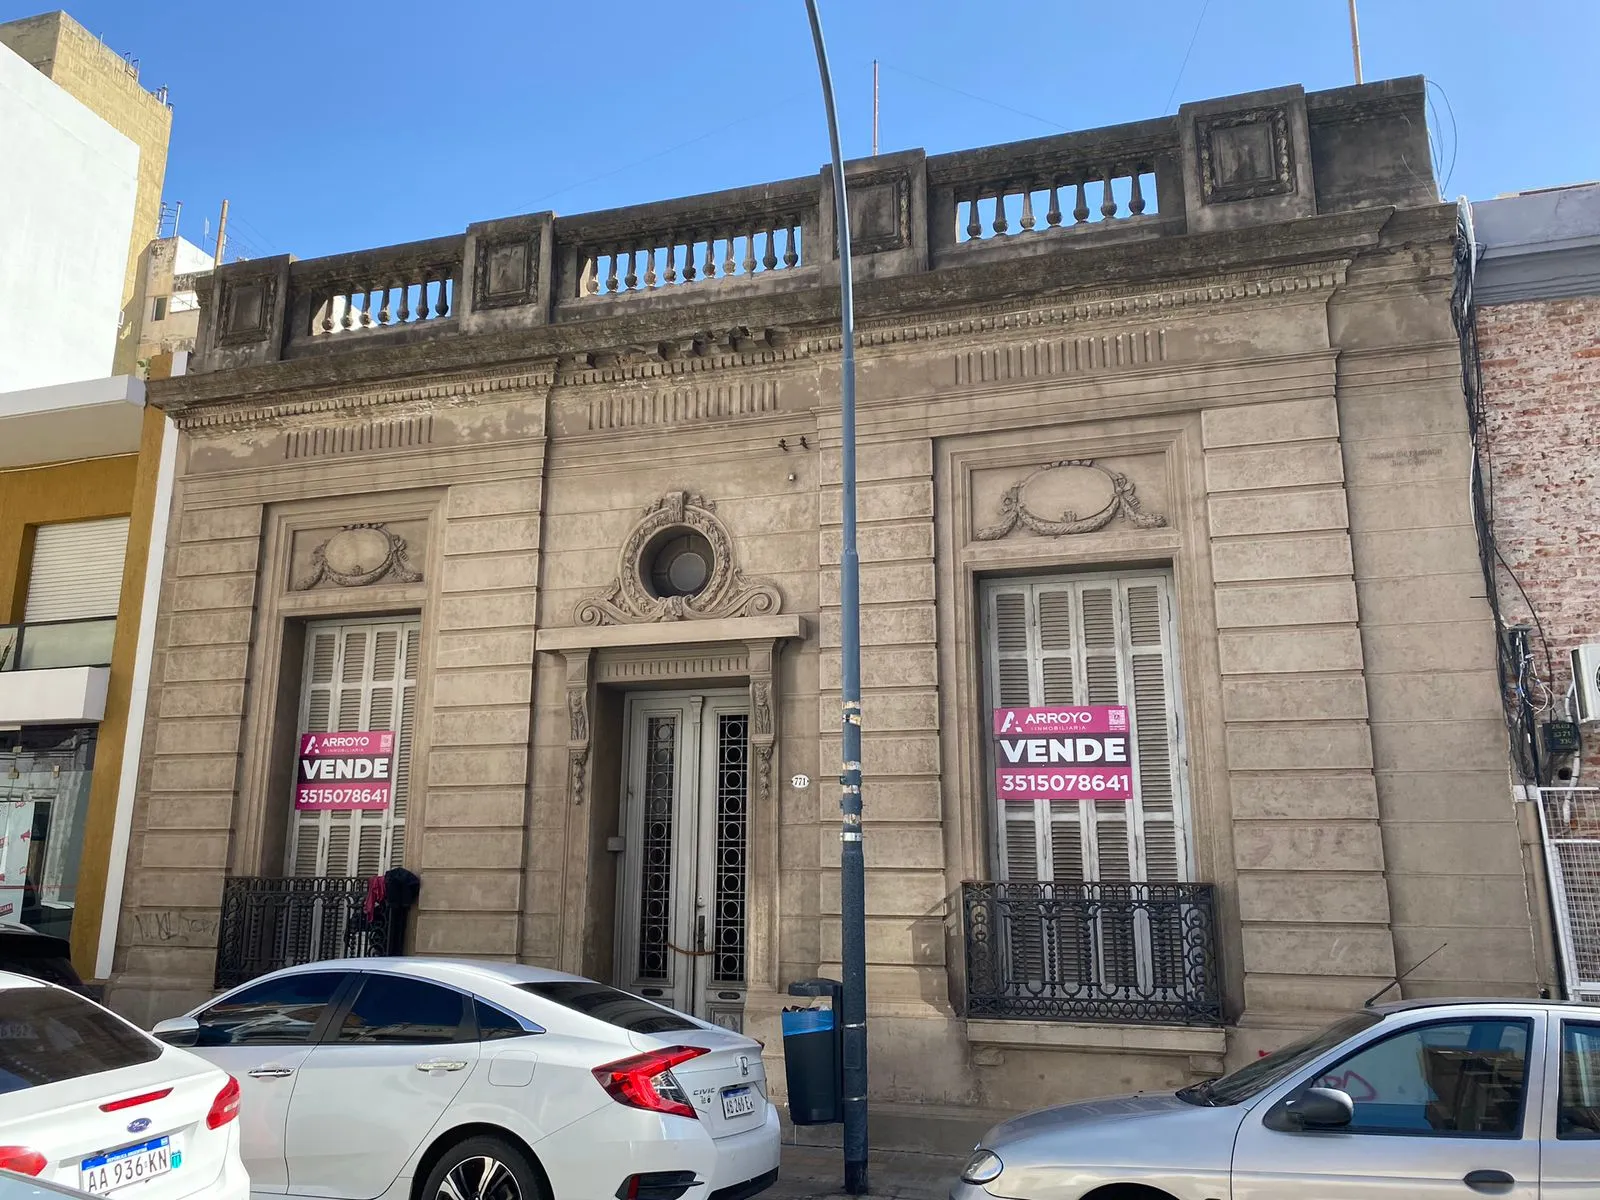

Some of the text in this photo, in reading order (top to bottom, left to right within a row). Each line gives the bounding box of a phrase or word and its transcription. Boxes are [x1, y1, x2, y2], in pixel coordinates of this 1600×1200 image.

[1025, 712, 1092, 724] ARROYO
[322, 737, 369, 747] ARROYO
[1000, 738, 1127, 763] VENDE
[302, 758, 389, 780] VENDE
[794, 777, 806, 786] 771
[1002, 775, 1129, 791] 3515078641
[299, 789, 387, 803] 3515078641
[693, 1088, 716, 1096] CIVIC
[88, 1148, 168, 1193] AA 936 KN
